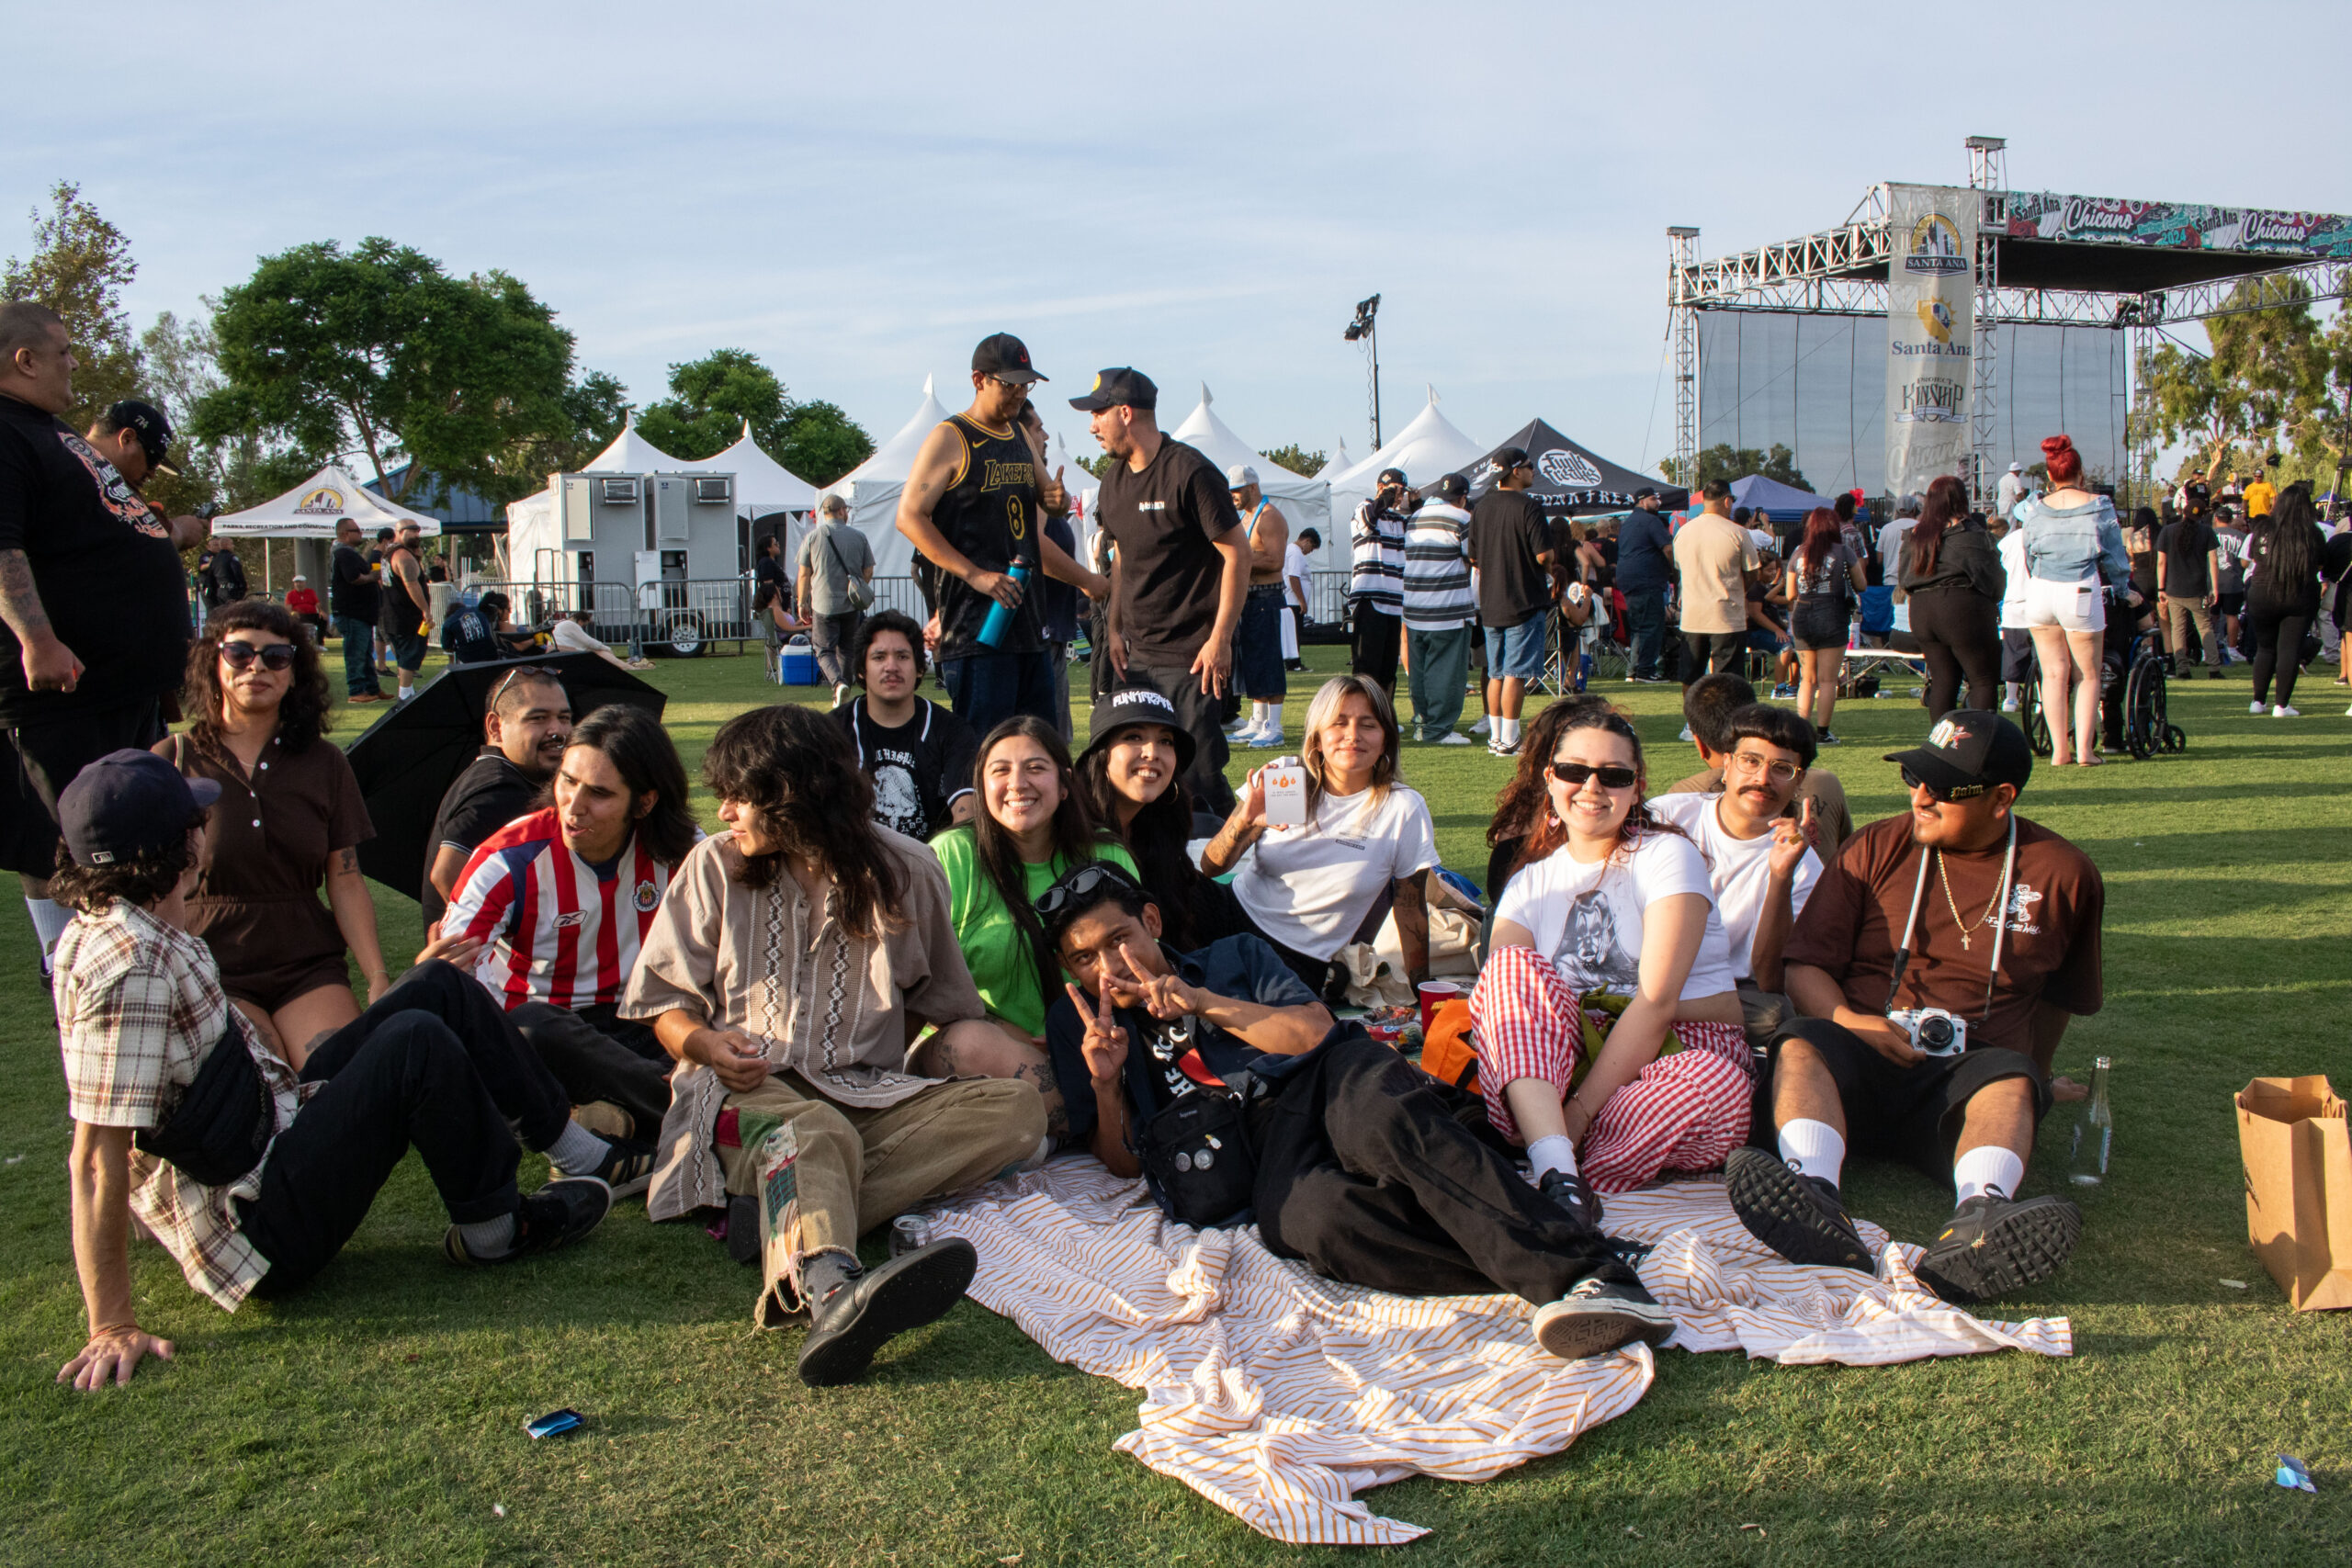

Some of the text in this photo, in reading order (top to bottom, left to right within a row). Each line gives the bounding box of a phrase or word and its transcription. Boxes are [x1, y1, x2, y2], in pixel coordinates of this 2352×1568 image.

[2014, 197, 2061, 222] Santa Ana
[2066, 197, 2133, 230] Chicano
[2196, 212, 2222, 234] Santa
[2222, 209, 2239, 225] Ana
[2162, 229, 2187, 245] 2024
[2243, 211, 2306, 243] Chicano
[2329, 243, 2352, 257] 202
[1907, 258, 1966, 268] SANTA ANA
[1892, 341, 1941, 356] Santa
[1007, 495, 1025, 540] 8
